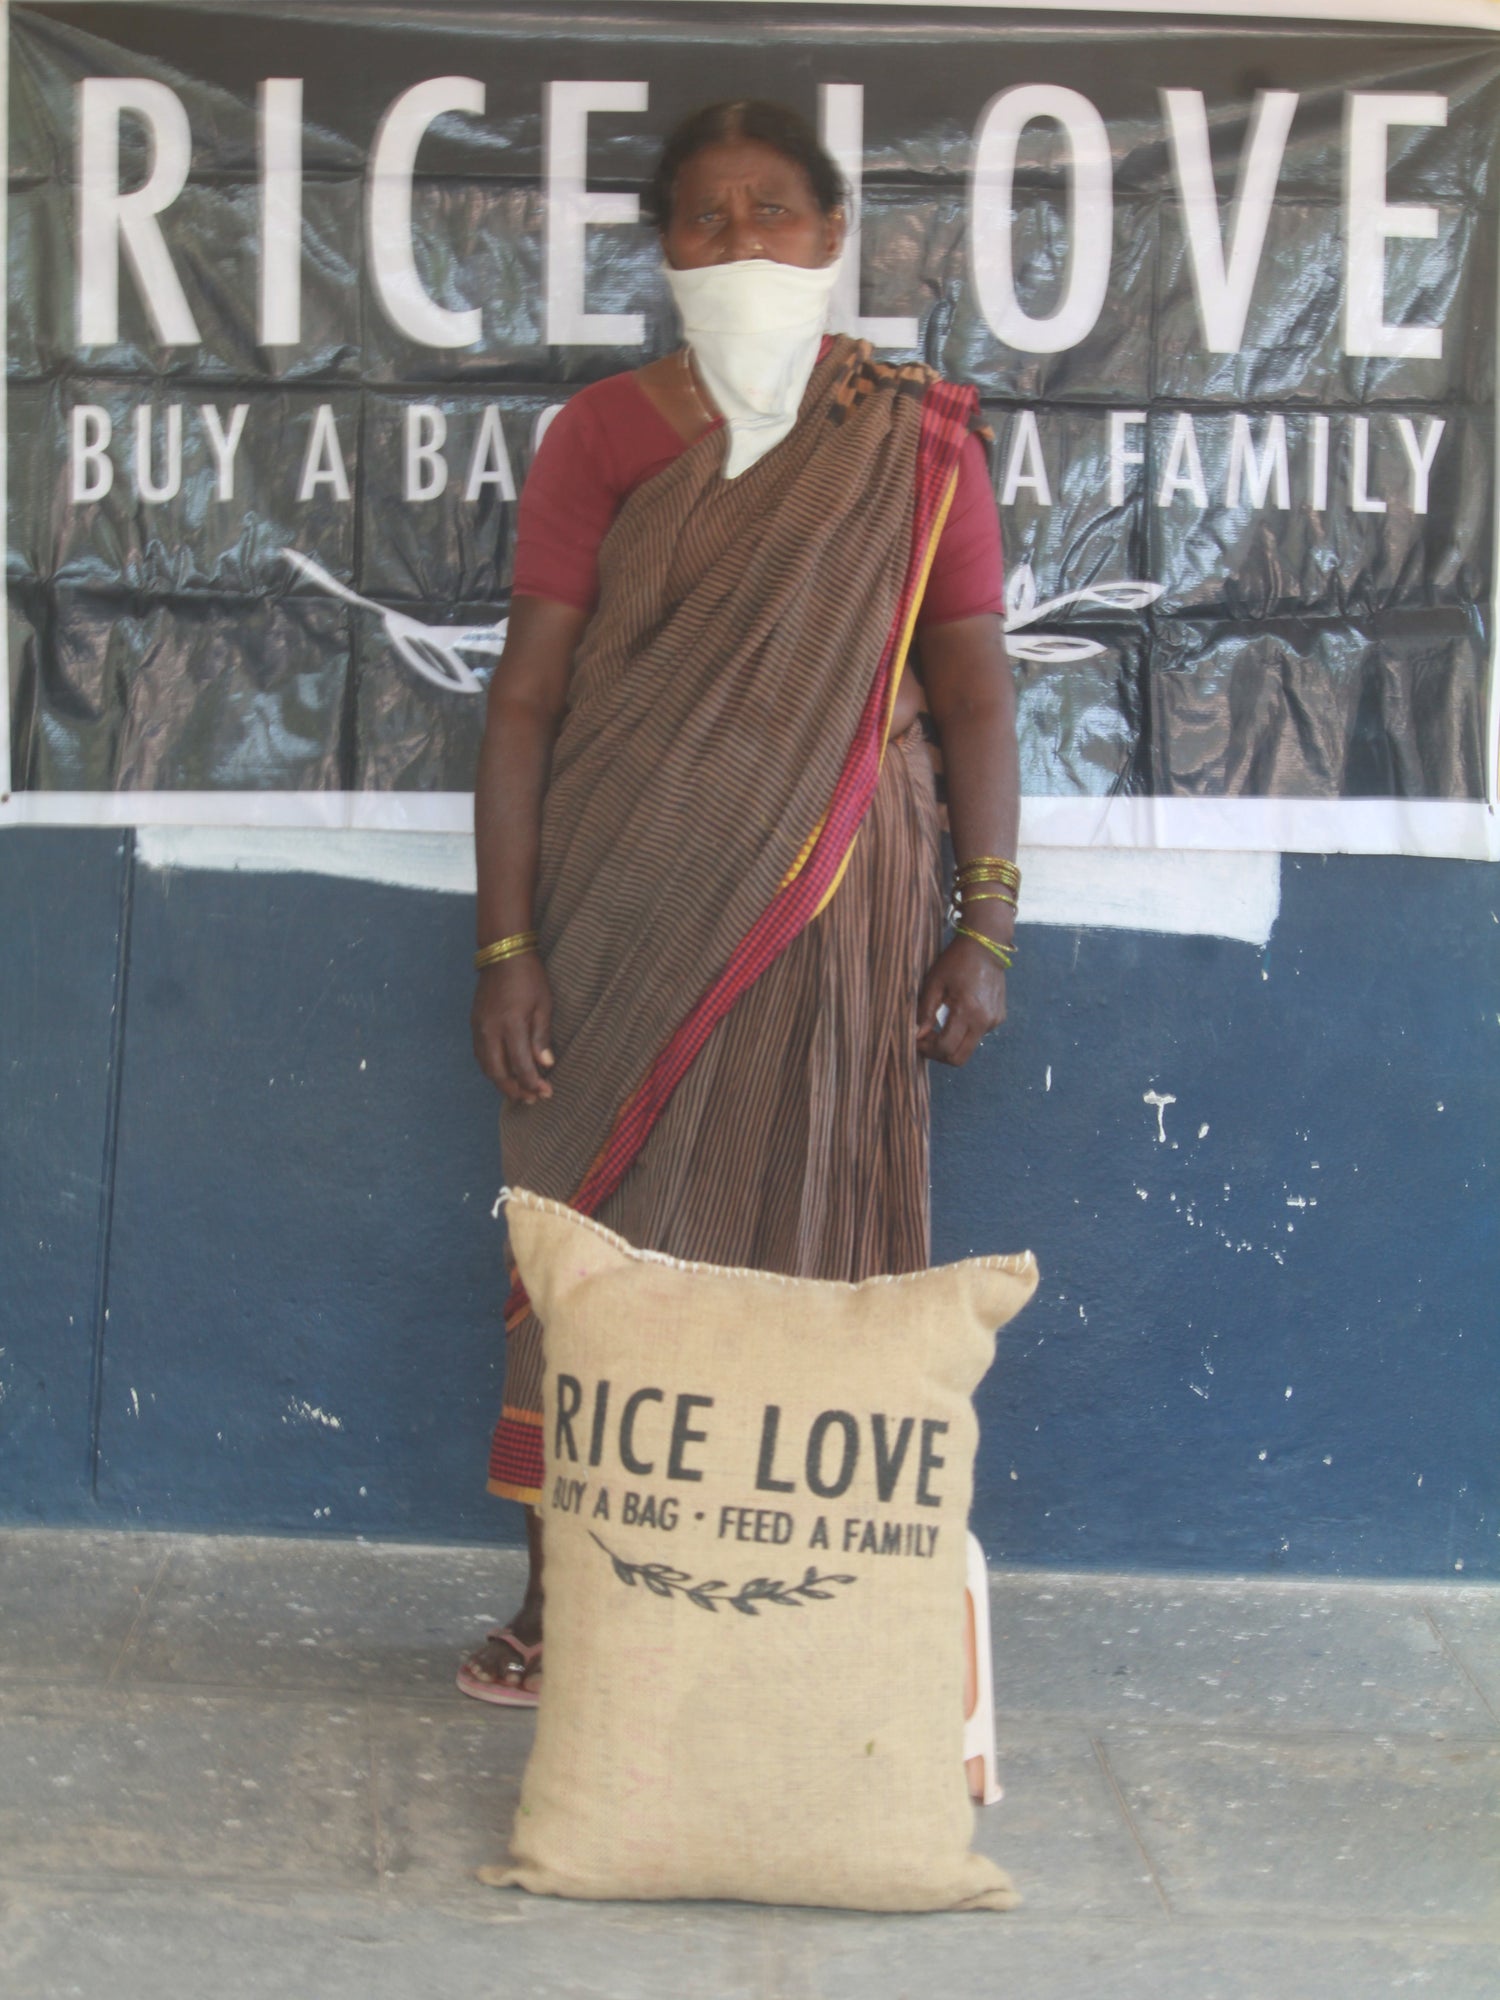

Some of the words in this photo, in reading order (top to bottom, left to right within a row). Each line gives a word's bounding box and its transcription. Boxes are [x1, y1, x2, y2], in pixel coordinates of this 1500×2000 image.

[77, 77, 649, 347] RICE
[820, 82, 1447, 359] LOVE
[70, 403, 250, 502] BUY
[298, 403, 352, 502] A
[403, 403, 566, 502] BA
[1001, 410, 1052, 506] A
[1108, 411, 1446, 514] FAMILY
[554, 1373, 715, 1483] RICE
[755, 1404, 950, 1508] LOVE
[552, 1476, 588, 1516] BUY
[592, 1486, 611, 1521] A
[621, 1491, 679, 1532] BAG
[718, 1505, 795, 1545] FEED
[808, 1515, 830, 1551] A
[842, 1517, 942, 1560] FAMILY
